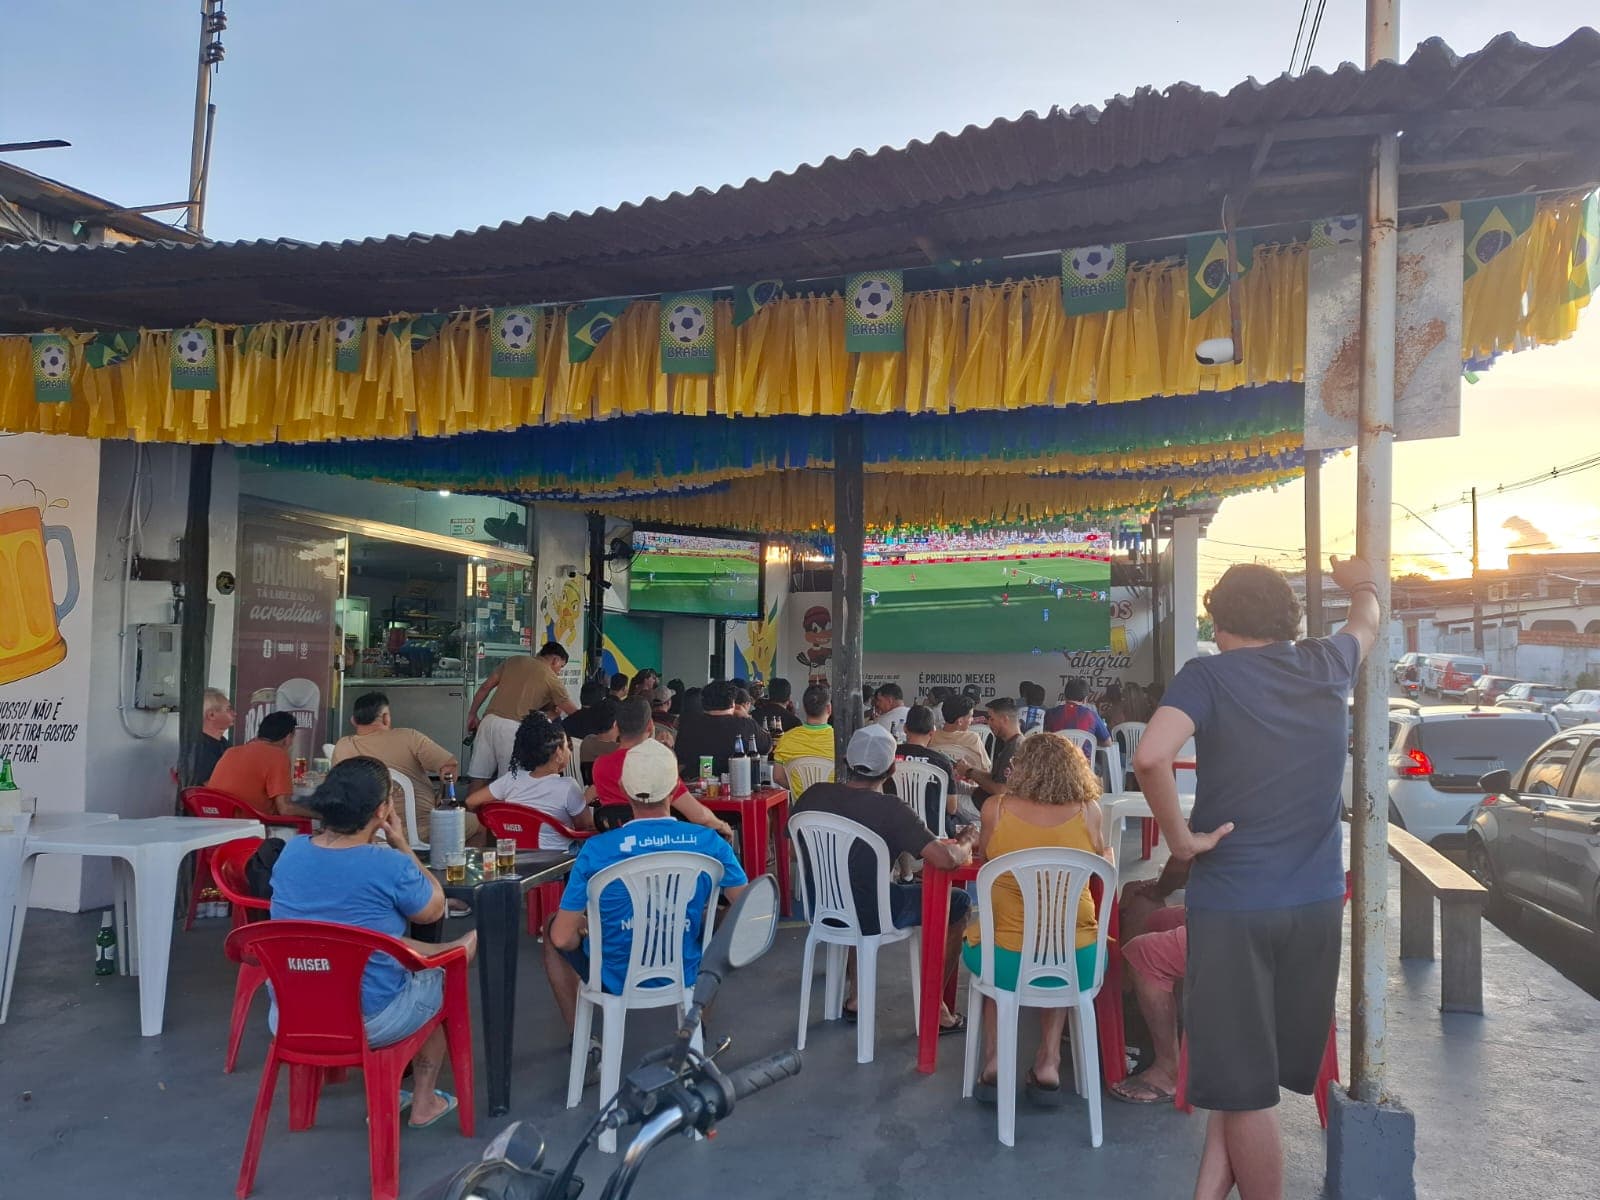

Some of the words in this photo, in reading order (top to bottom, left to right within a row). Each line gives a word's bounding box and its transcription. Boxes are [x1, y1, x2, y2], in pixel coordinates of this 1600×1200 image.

[1071, 283, 1118, 298] BRASIL
[852, 323, 896, 337] BRASIL
[667, 346, 709, 359] BRASIL
[176, 366, 210, 377] BRASIL
[270, 589, 316, 602] LIBERADO
[249, 602, 323, 623] acreditar
[925, 673, 962, 684] PROIBIDO
[965, 673, 996, 684] MEXER
[31, 699, 53, 720] NÃO
[52, 697, 65, 720] É
[10, 723, 23, 741] DE
[22, 723, 79, 742] TIRA-GOSTOS
[287, 957, 330, 971] KAISER
